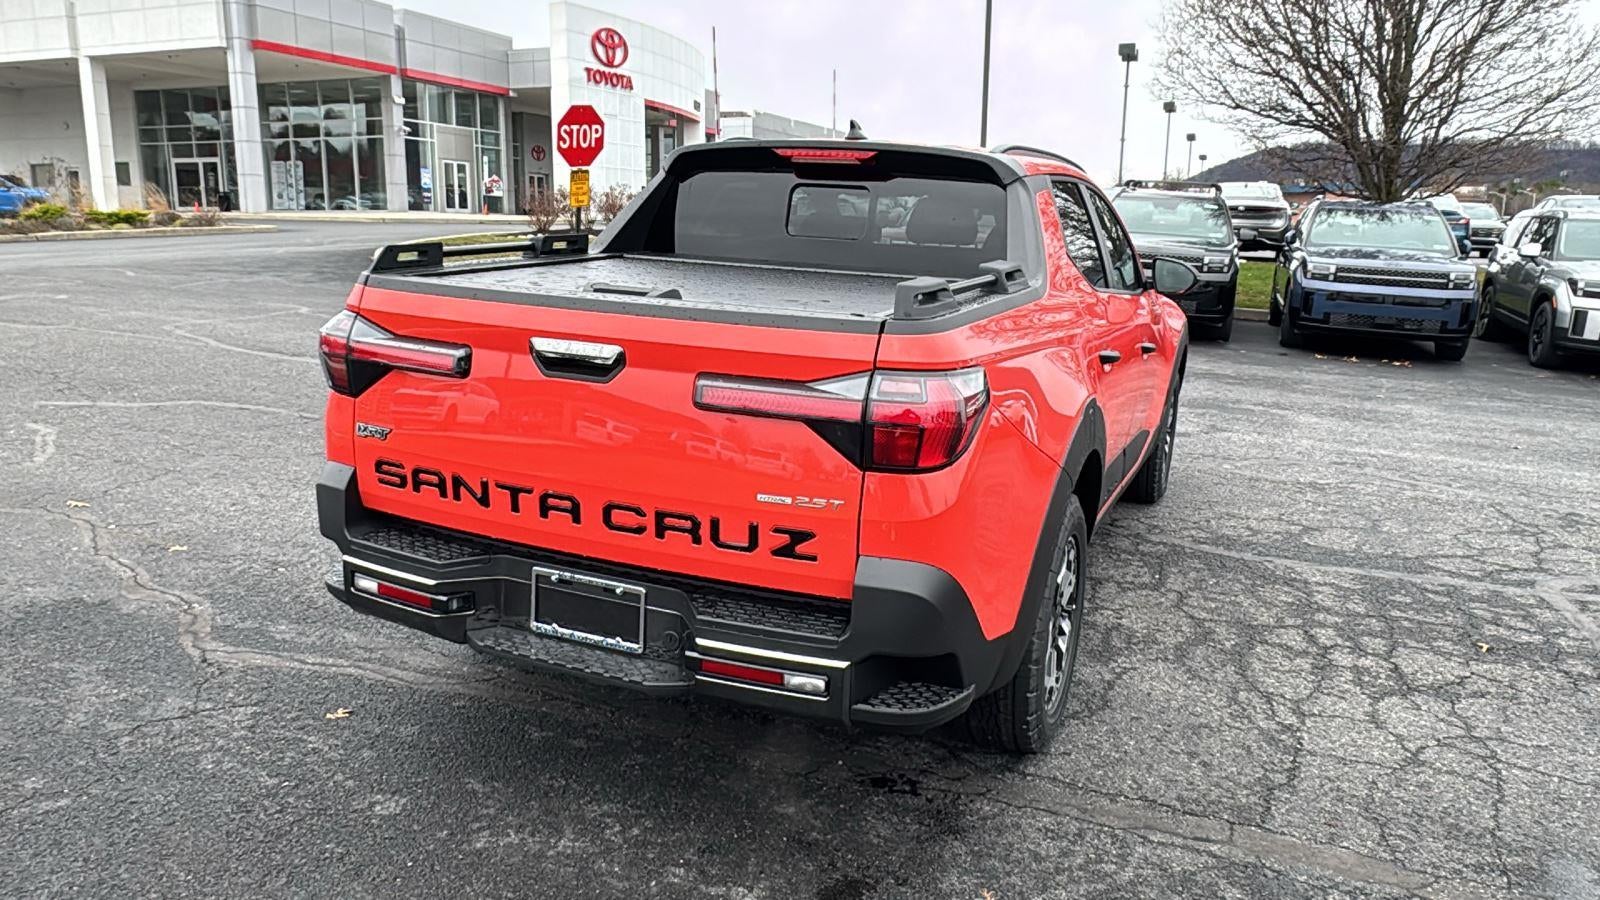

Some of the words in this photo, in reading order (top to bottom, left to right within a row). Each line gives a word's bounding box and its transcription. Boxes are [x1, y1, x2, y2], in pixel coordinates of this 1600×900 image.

[584, 67, 634, 90] TOYOTA
[560, 124, 602, 148] STOP
[357, 422, 391, 440] XRT
[374, 457, 581, 525] SANTA
[602, 501, 818, 563] CRUZ
